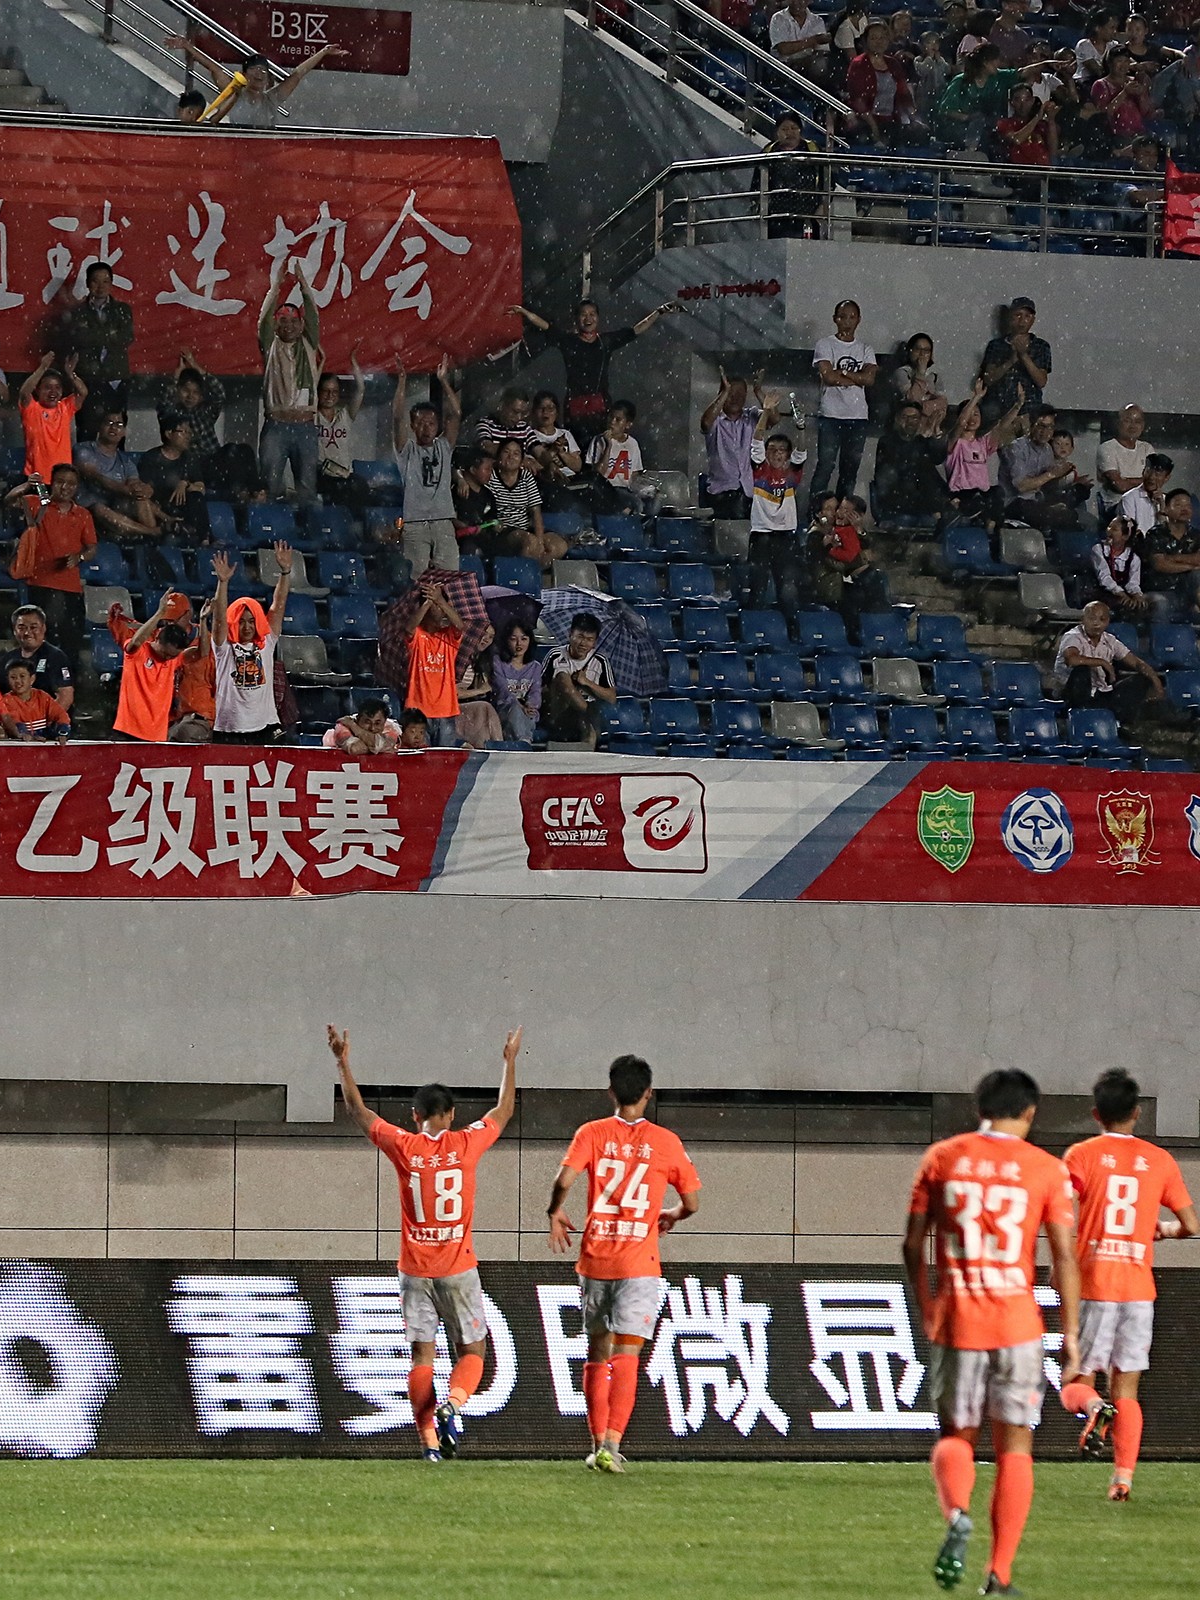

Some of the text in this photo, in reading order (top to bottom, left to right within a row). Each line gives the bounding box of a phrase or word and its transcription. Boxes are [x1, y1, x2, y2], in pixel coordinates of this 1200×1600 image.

[271, 11, 329, 44] B3区
[280, 44, 317, 56] Area B3
[542, 797, 603, 827] CFA
[409, 1168, 463, 1223] 18
[593, 1157, 651, 1218] 24
[1104, 1174, 1139, 1236] 8
[943, 1179, 1029, 1264] 33
